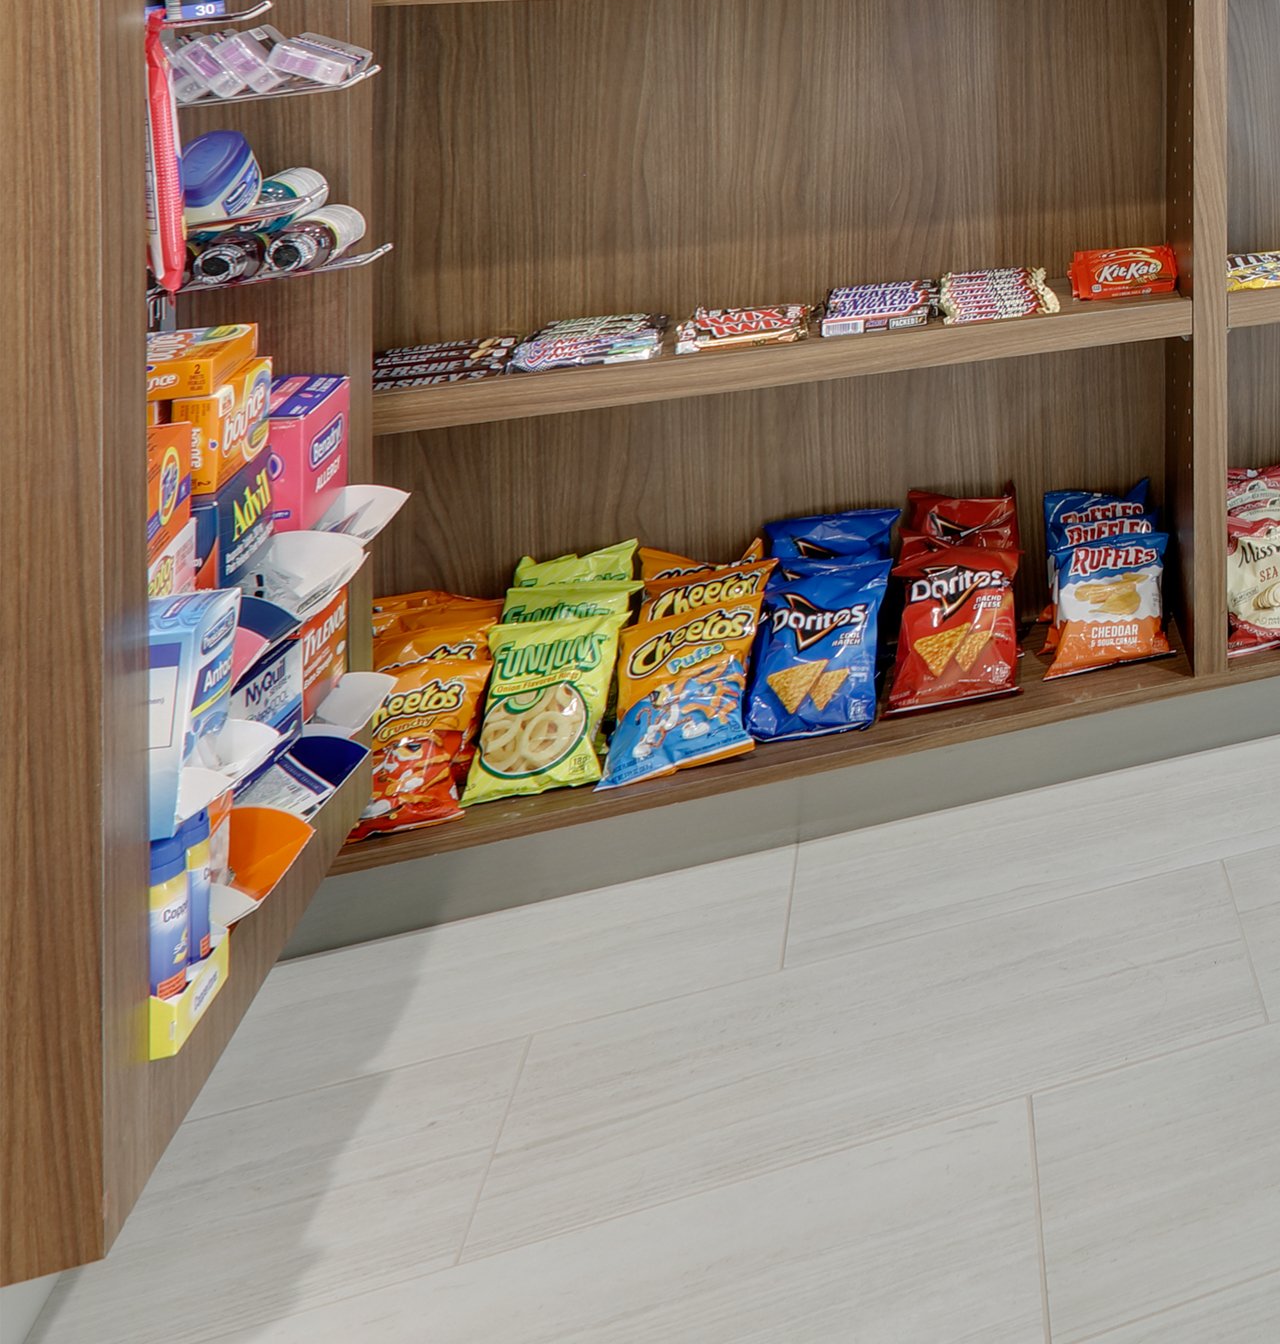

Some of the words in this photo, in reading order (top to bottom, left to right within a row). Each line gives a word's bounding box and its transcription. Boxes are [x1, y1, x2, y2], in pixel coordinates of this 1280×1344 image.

[195, 4, 215, 16] 30
[1099, 261, 1159, 283] KitKat
[713, 317, 797, 336] TWIX
[892, 318, 915, 327] PACKED
[194, 364, 201, 374] 2
[373, 357, 499, 378] ERSHEY'S
[223, 383, 264, 451] bounce
[312, 417, 342, 462] Benadryl
[315, 455, 341, 493] ALLERGY
[232, 468, 272, 542] Advil
[1069, 546, 1157, 576] RUFFLES
[1238, 541, 1272, 568] Miss
[911, 567, 1003, 603] Doritos
[1259, 568, 1279, 584] SEA
[973, 601, 1002, 610] CHEESE
[975, 594, 1002, 603] NACHO
[303, 601, 346, 665] TYLENOL
[772, 604, 868, 635] Doritos
[1091, 624, 1139, 638] CHEDDAR
[626, 608, 757, 680] Cheetos
[832, 636, 862, 647] RANCH
[840, 632, 862, 643] COOL
[666, 643, 725, 675] Puffs
[245, 658, 286, 706] NyQuil
[496, 683, 522, 694] Onion
[523, 675, 558, 689] Flavored
[559, 670, 579, 684] Rings
[373, 678, 466, 723] heetos
[377, 714, 437, 742] Crunchy
